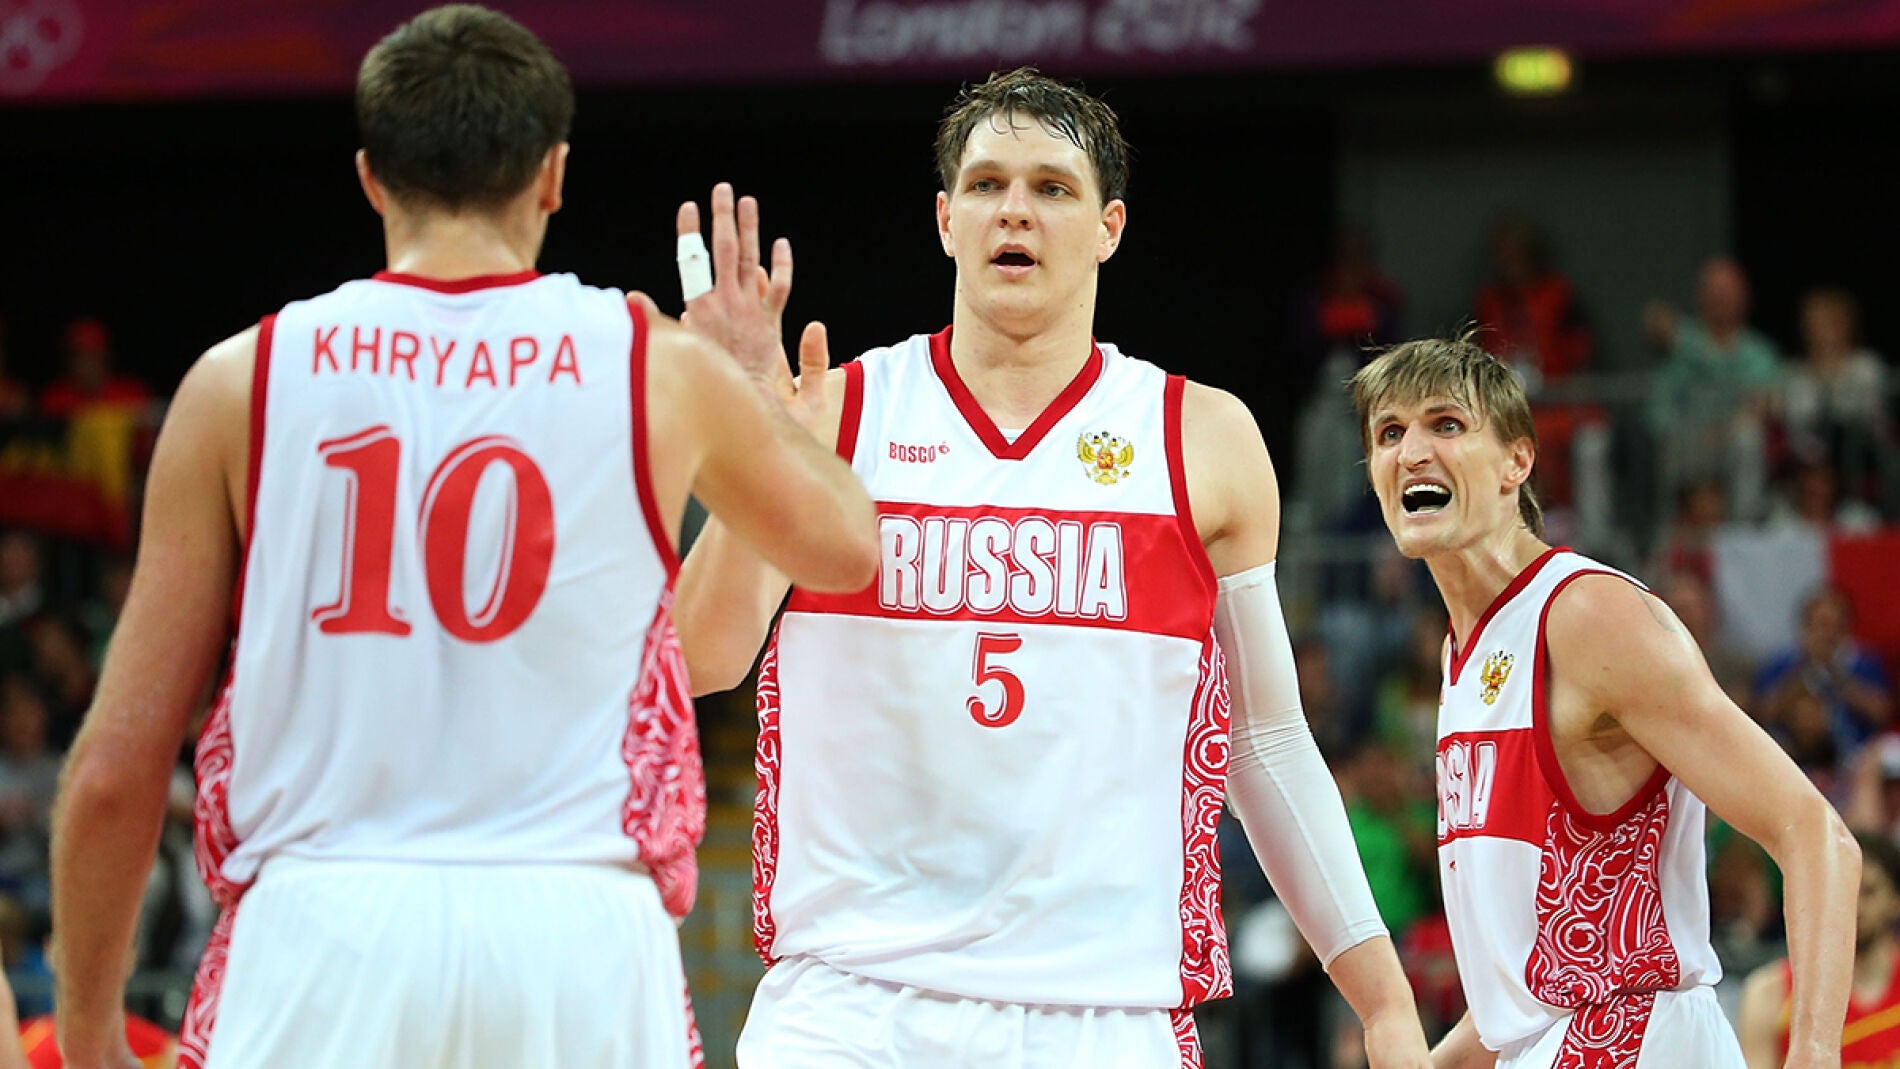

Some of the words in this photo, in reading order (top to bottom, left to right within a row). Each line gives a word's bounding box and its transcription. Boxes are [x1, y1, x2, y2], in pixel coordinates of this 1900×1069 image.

[312, 325, 583, 388] KHRYAPA
[889, 441, 936, 463] BOSCO
[311, 424, 556, 643] 10
[878, 514, 1128, 621] RUSSIA
[966, 631, 1025, 728] 5
